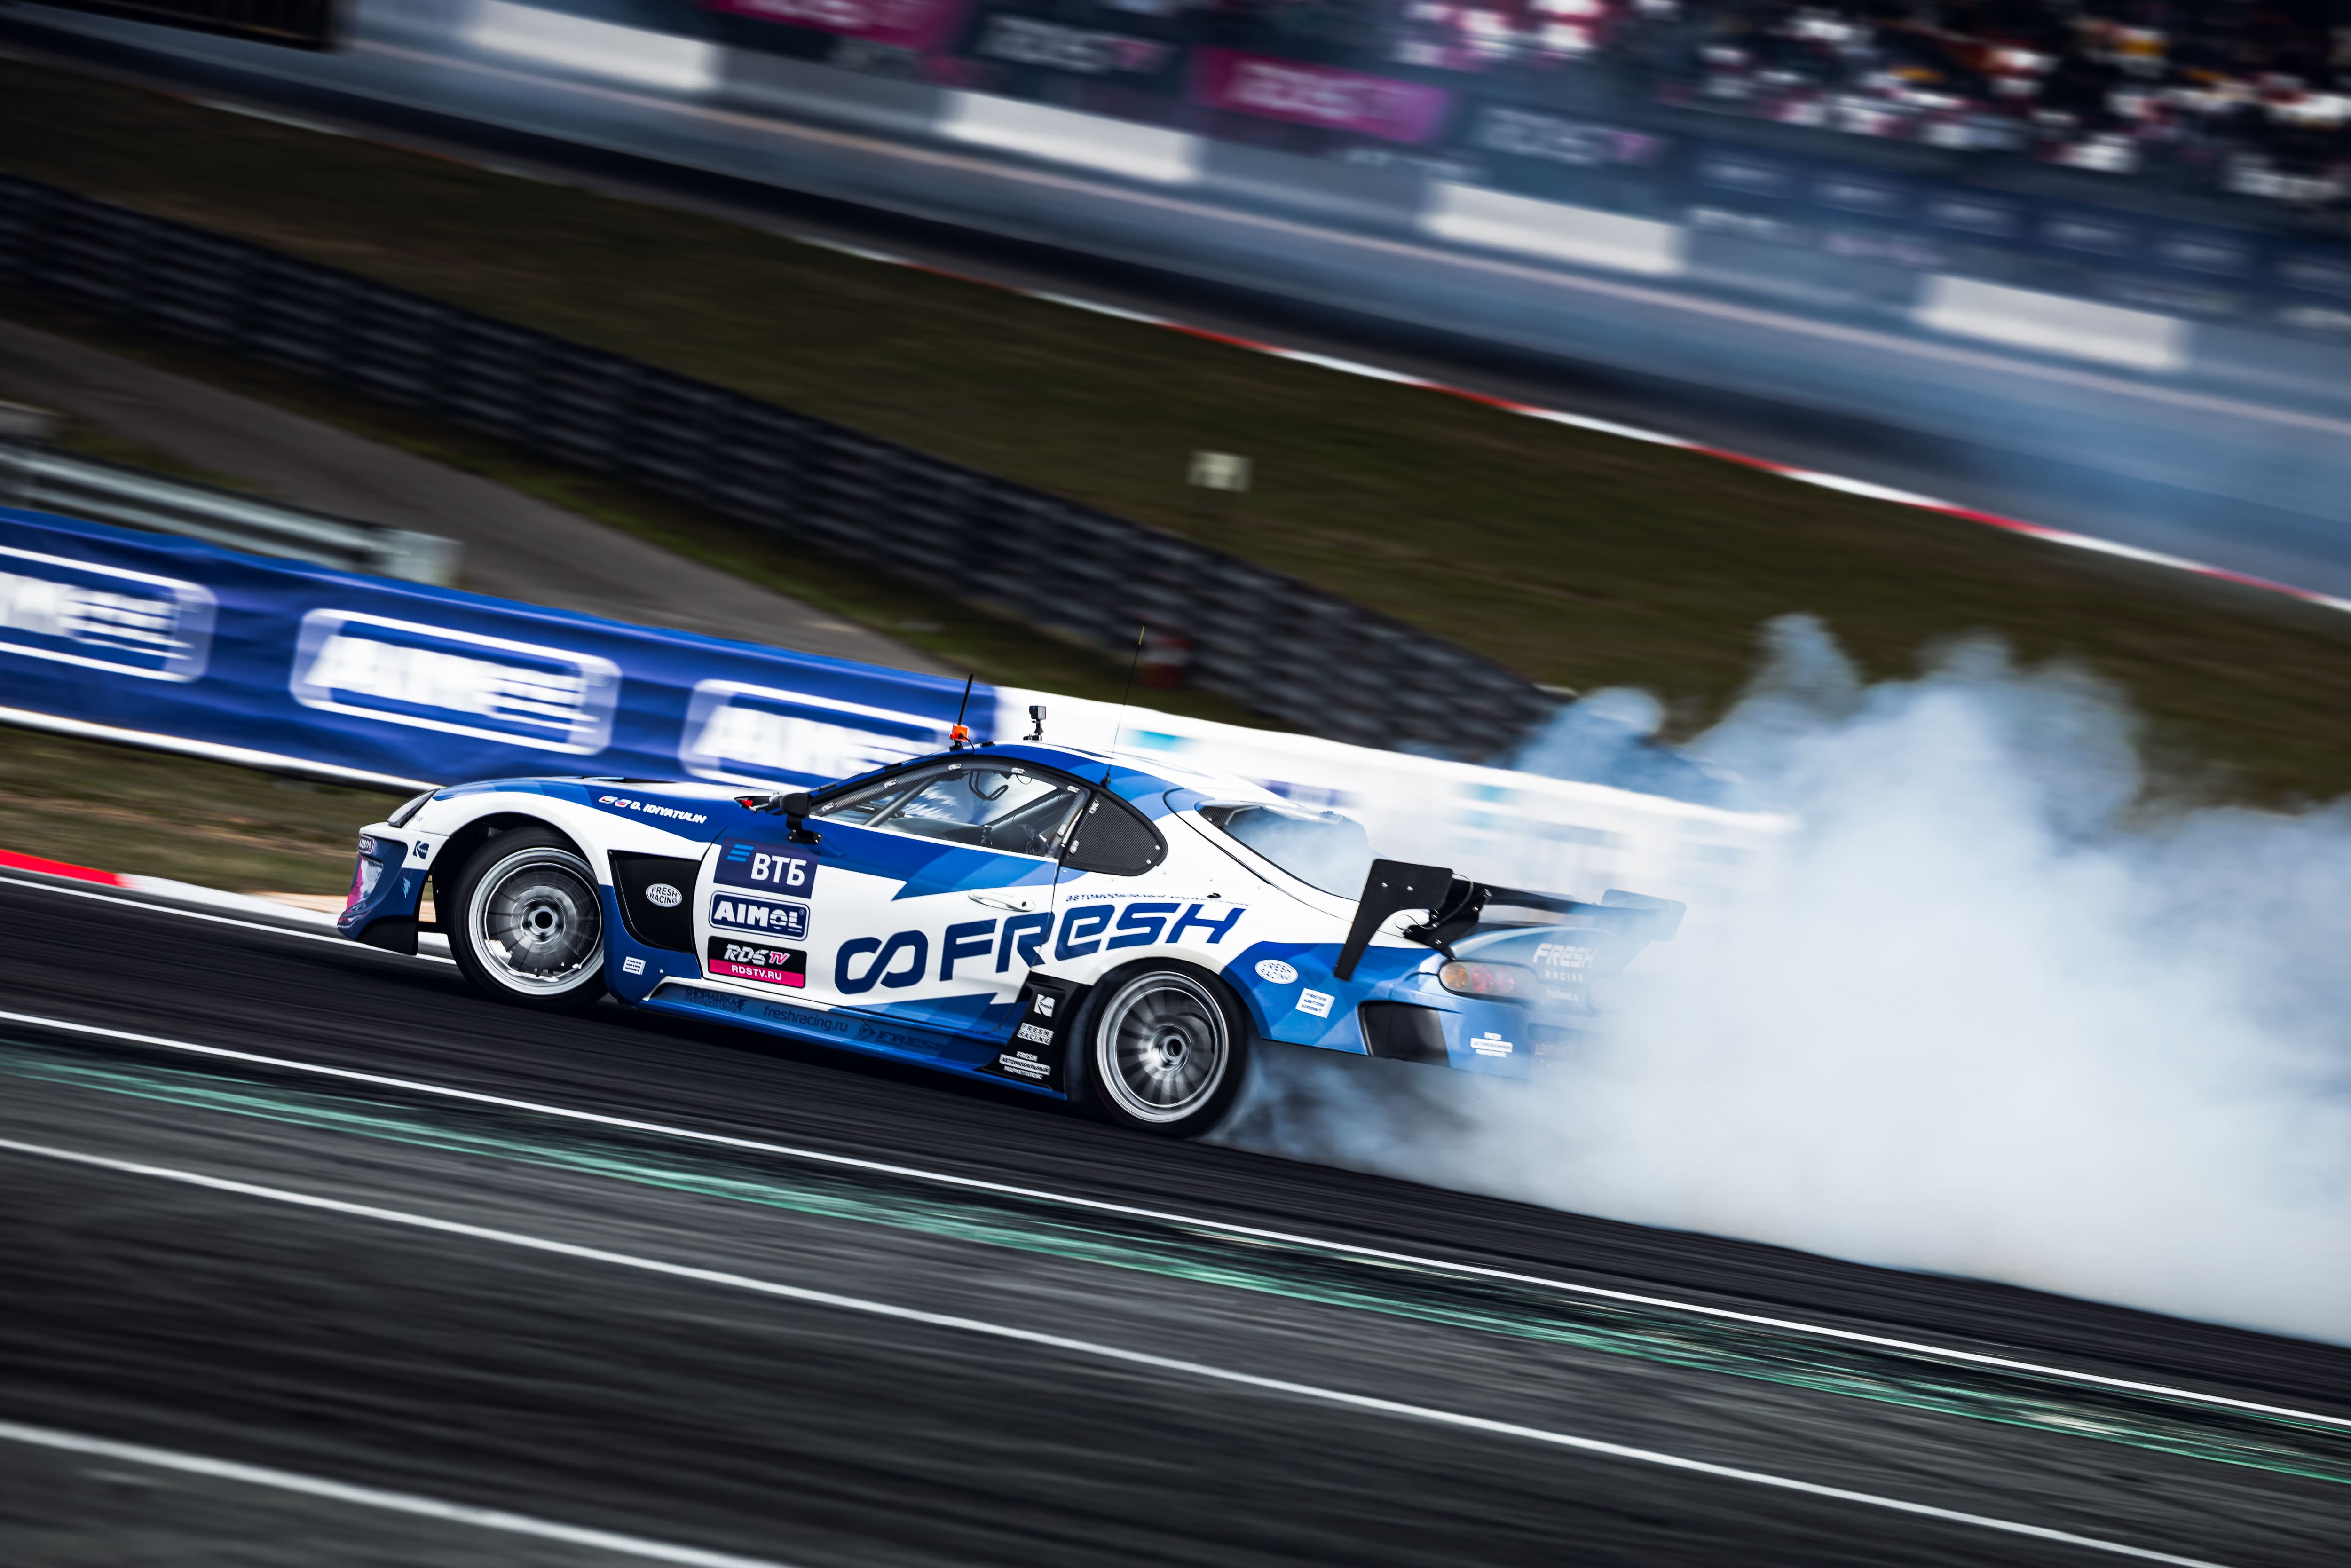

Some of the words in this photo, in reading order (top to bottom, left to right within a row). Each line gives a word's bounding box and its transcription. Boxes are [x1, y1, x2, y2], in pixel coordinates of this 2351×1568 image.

[630, 801, 641, 811] D.
[643, 804, 707, 824] IDIYATULIN
[751, 852, 807, 886] ВТБ
[649, 892, 678, 904] RACING
[651, 886, 678, 897] FRESH
[714, 900, 803, 933] AIMOL
[731, 964, 782, 981] RDSTV.RU
[685, 987, 737, 1007] SHOPMARKA
[763, 1005, 848, 1032] freshracing.ru
[1018, 1030, 1051, 1045] RACING
[1020, 1023, 1051, 1037] FRESH
